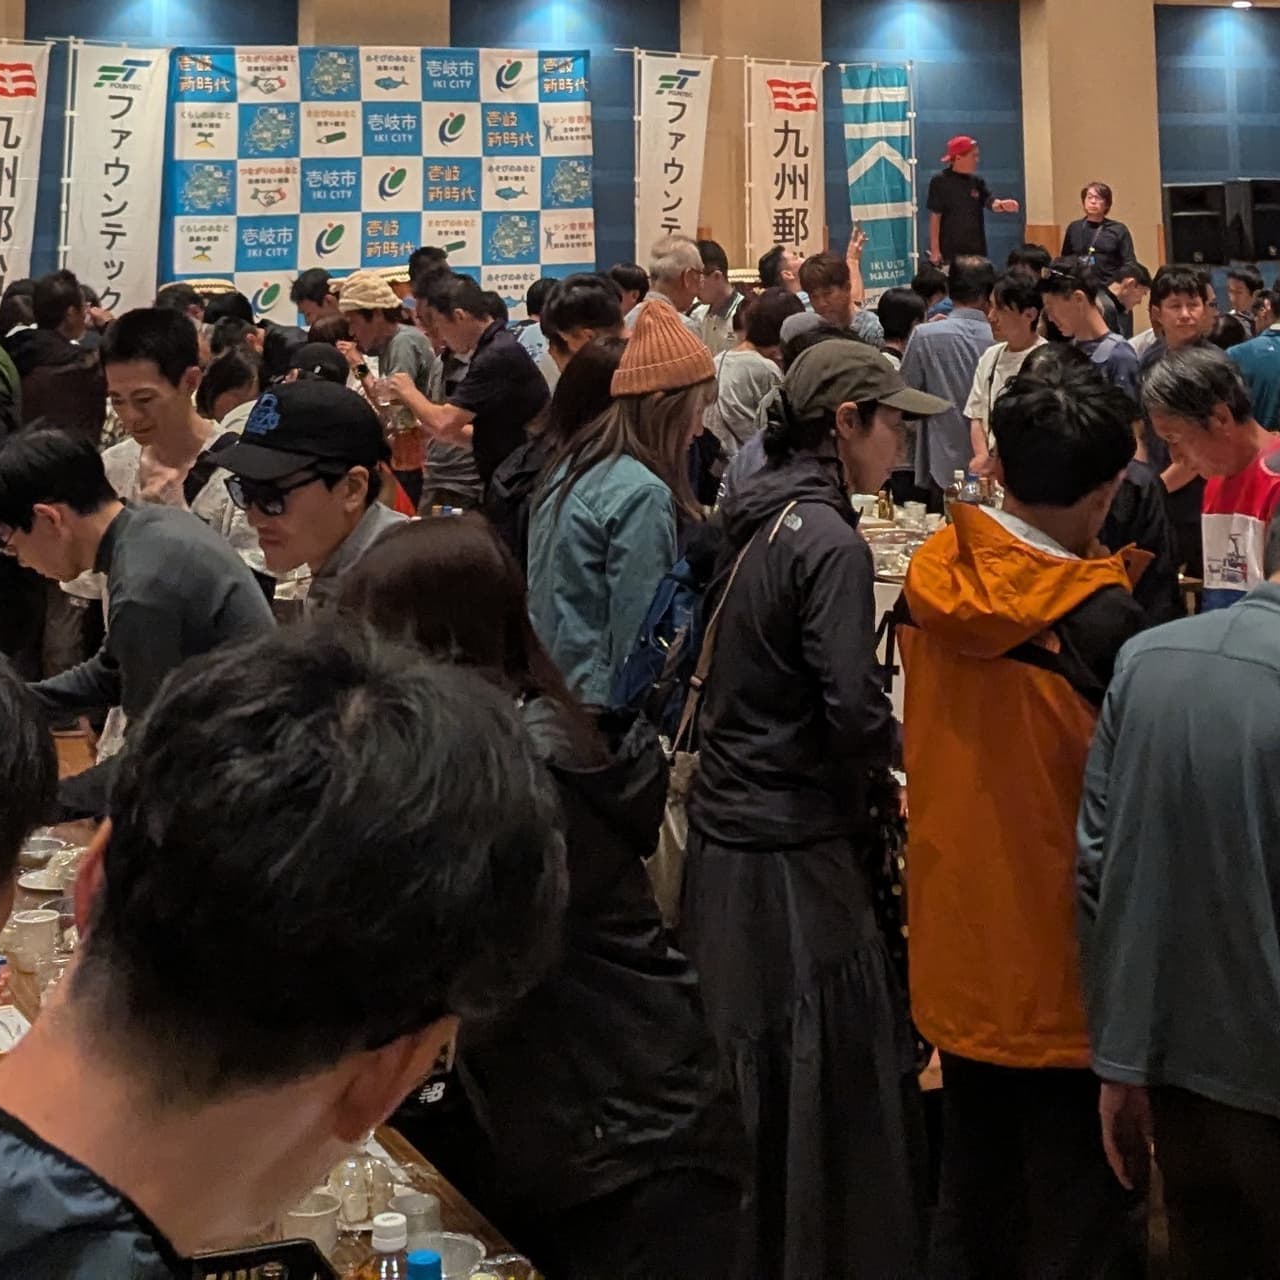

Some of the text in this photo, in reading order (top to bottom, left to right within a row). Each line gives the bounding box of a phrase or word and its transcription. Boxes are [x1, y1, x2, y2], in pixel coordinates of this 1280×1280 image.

[426, 60, 475, 77] 壱岐市
[433, 80, 472, 88] IKI CITY
[368, 113, 417, 131] 壱岐市
[391, 134, 414, 143] CITY
[486, 131, 535, 148] 新時代
[660, 101, 687, 236] ファウンテ
[306, 170, 357, 188] 壱岐市
[772, 119, 810, 248] 九州郵
[330, 190, 353, 199] CITY
[428, 186, 476, 202] 新時代
[97, 94, 135, 312] ファウンテック
[242, 227, 295, 246] 壱岐市
[266, 248, 289, 257] CITY
